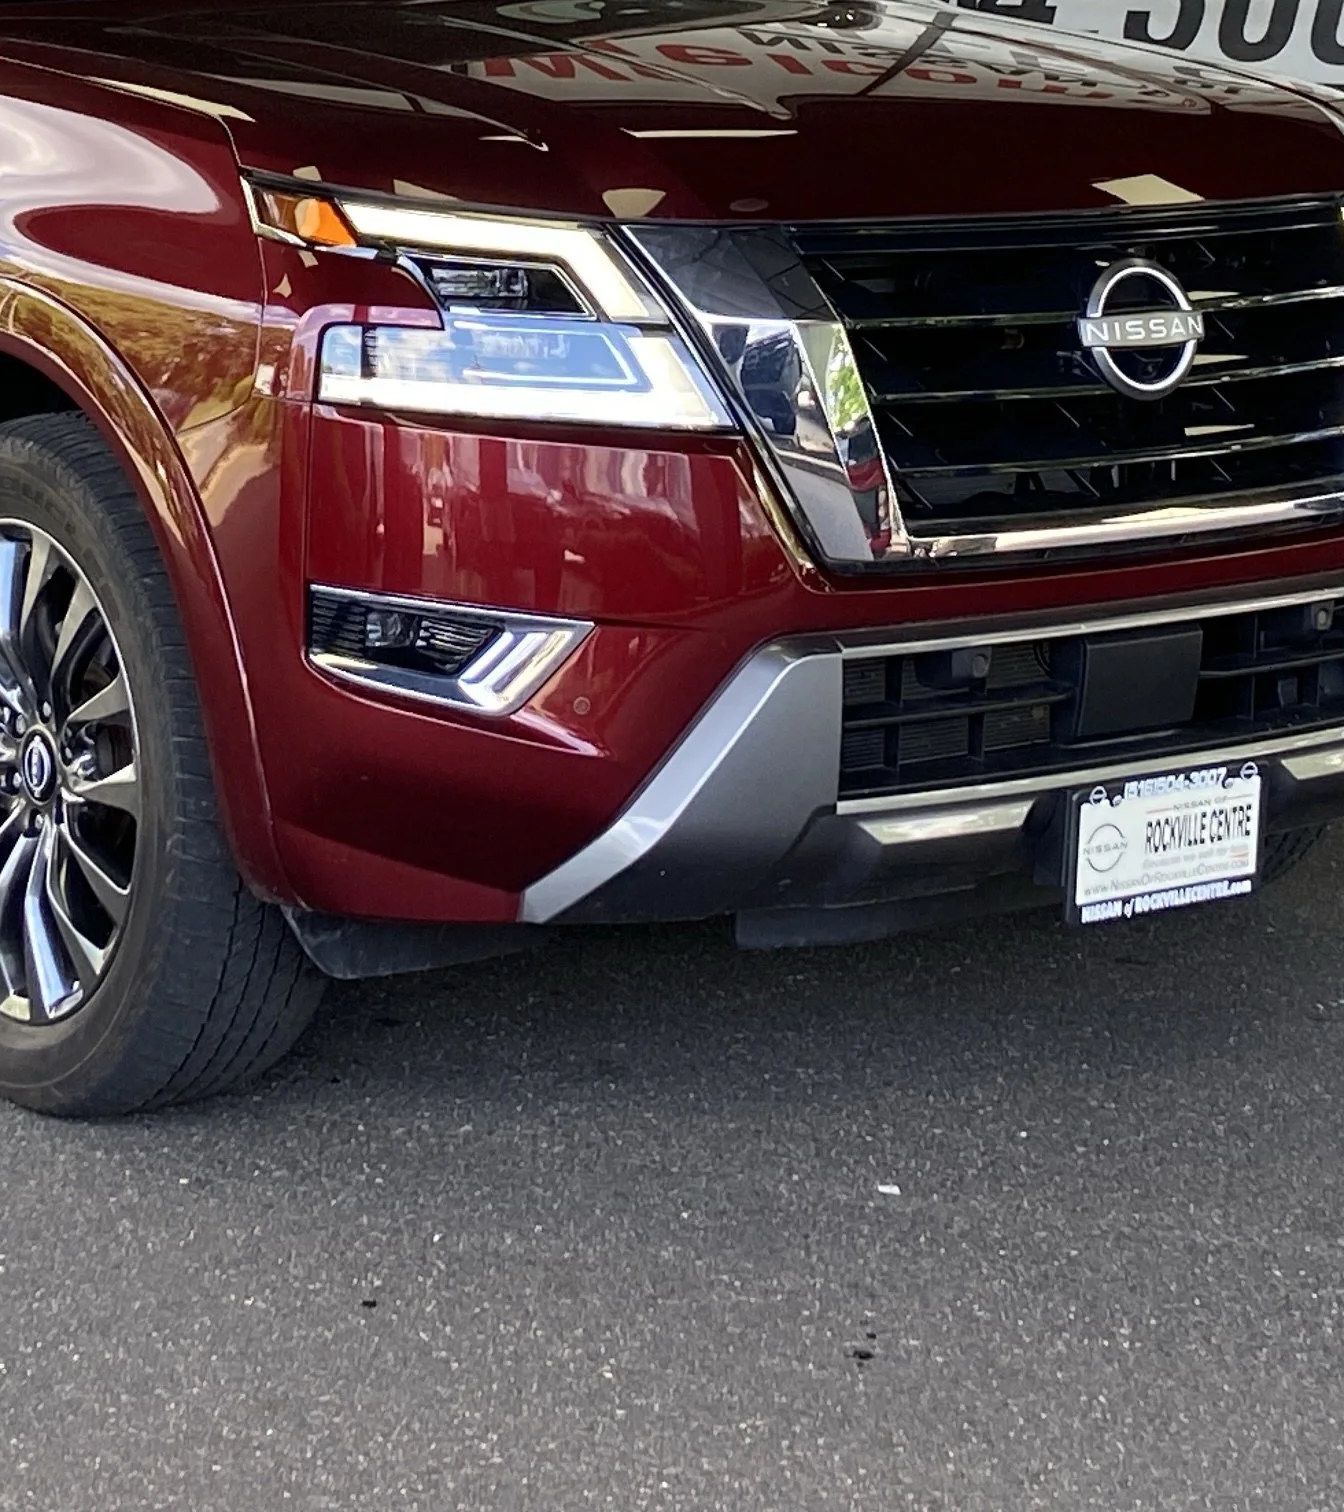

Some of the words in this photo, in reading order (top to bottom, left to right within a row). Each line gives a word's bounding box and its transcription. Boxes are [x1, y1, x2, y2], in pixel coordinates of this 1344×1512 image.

[1085, 313, 1204, 343] NISSAN
[1145, 811, 1207, 854] ROCKVILLE
[1209, 804, 1253, 844] CENTRE
[1082, 841, 1128, 855] NISSAN
[1081, 900, 1122, 924] NISSAN
